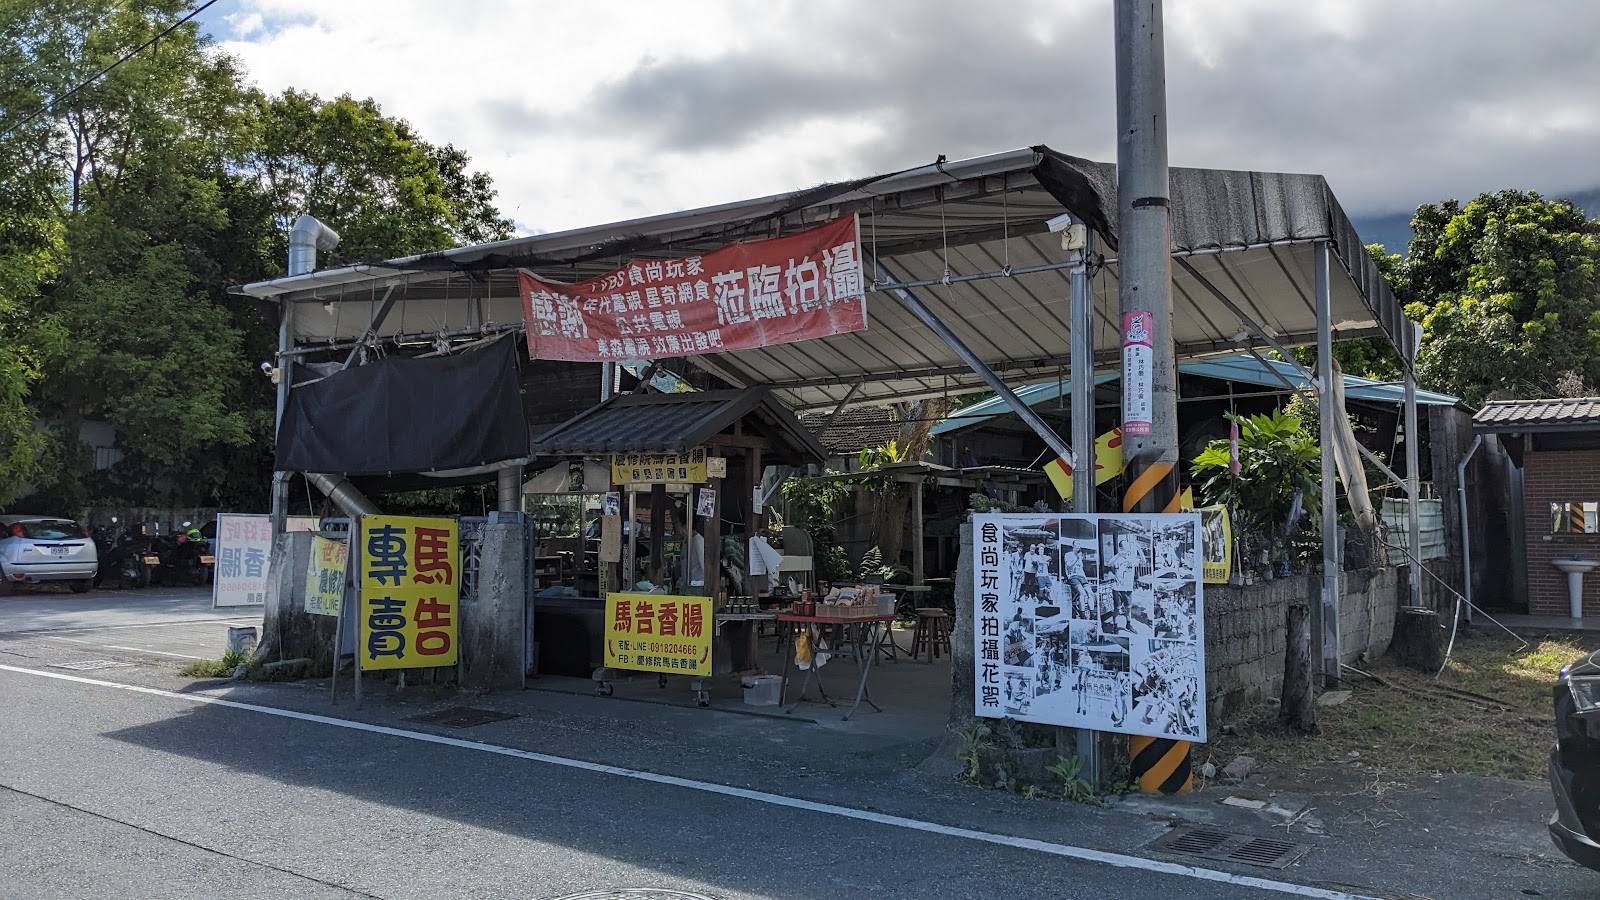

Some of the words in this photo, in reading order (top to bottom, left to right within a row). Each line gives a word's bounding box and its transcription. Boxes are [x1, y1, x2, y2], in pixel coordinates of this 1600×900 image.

[628, 256, 705, 286] 食尚玩家
[711, 241, 861, 326] 蒞臨拍攝
[530, 290, 588, 338] 感謝
[582, 291, 643, 315] 年代電視
[645, 279, 710, 309] 星奇網食
[615, 309, 685, 335] 公共電視
[597, 337, 651, 358] 東森電視
[368, 524, 408, 660] 專賣
[413, 526, 453, 656] 馬告
[613, 600, 703, 638] 馬告香腸
[980, 522, 999, 708] 食尚玩家拍攝花絮
